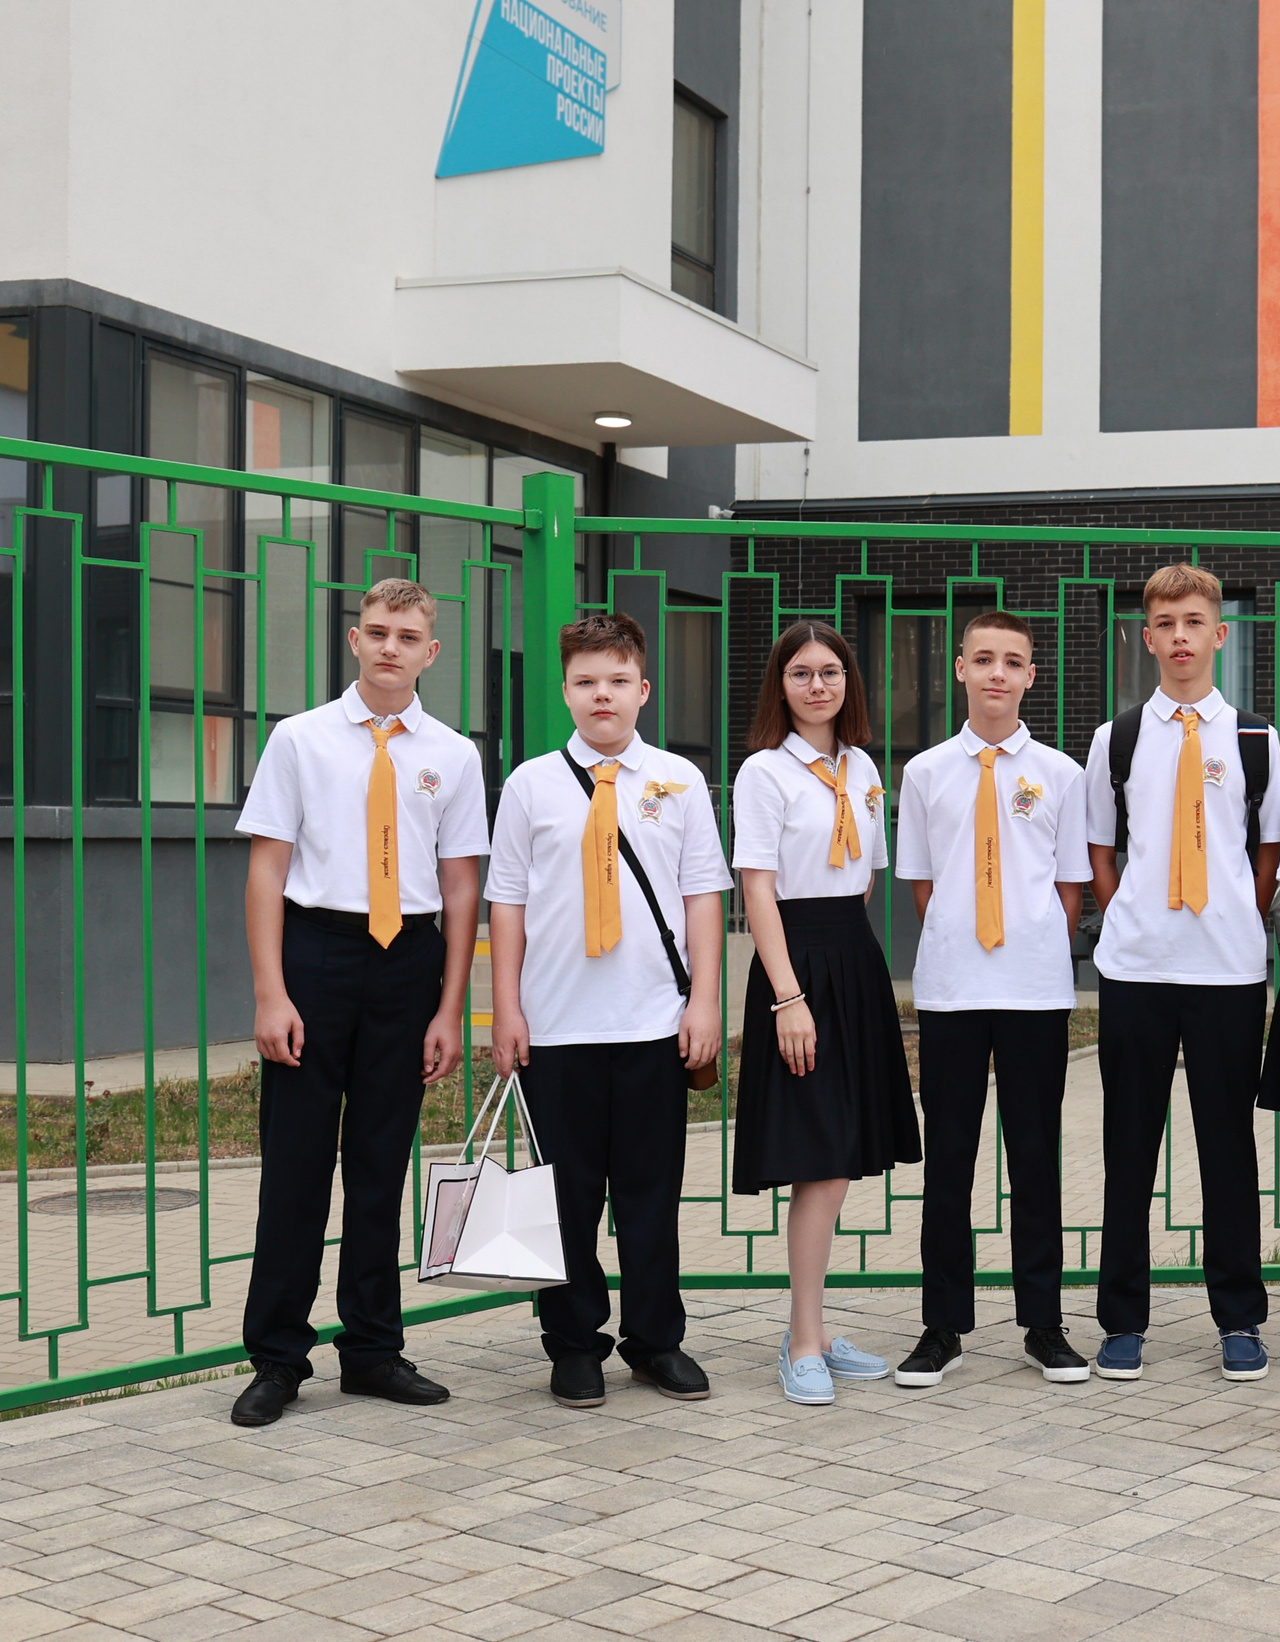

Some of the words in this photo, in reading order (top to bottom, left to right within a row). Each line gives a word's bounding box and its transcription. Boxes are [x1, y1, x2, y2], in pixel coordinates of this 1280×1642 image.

[501, 0, 605, 84] НАЦИОНАЛЬНЫЕ
[546, 53, 604, 117] ПРОЕКТЫ
[556, 93, 604, 147] РОССИИ
